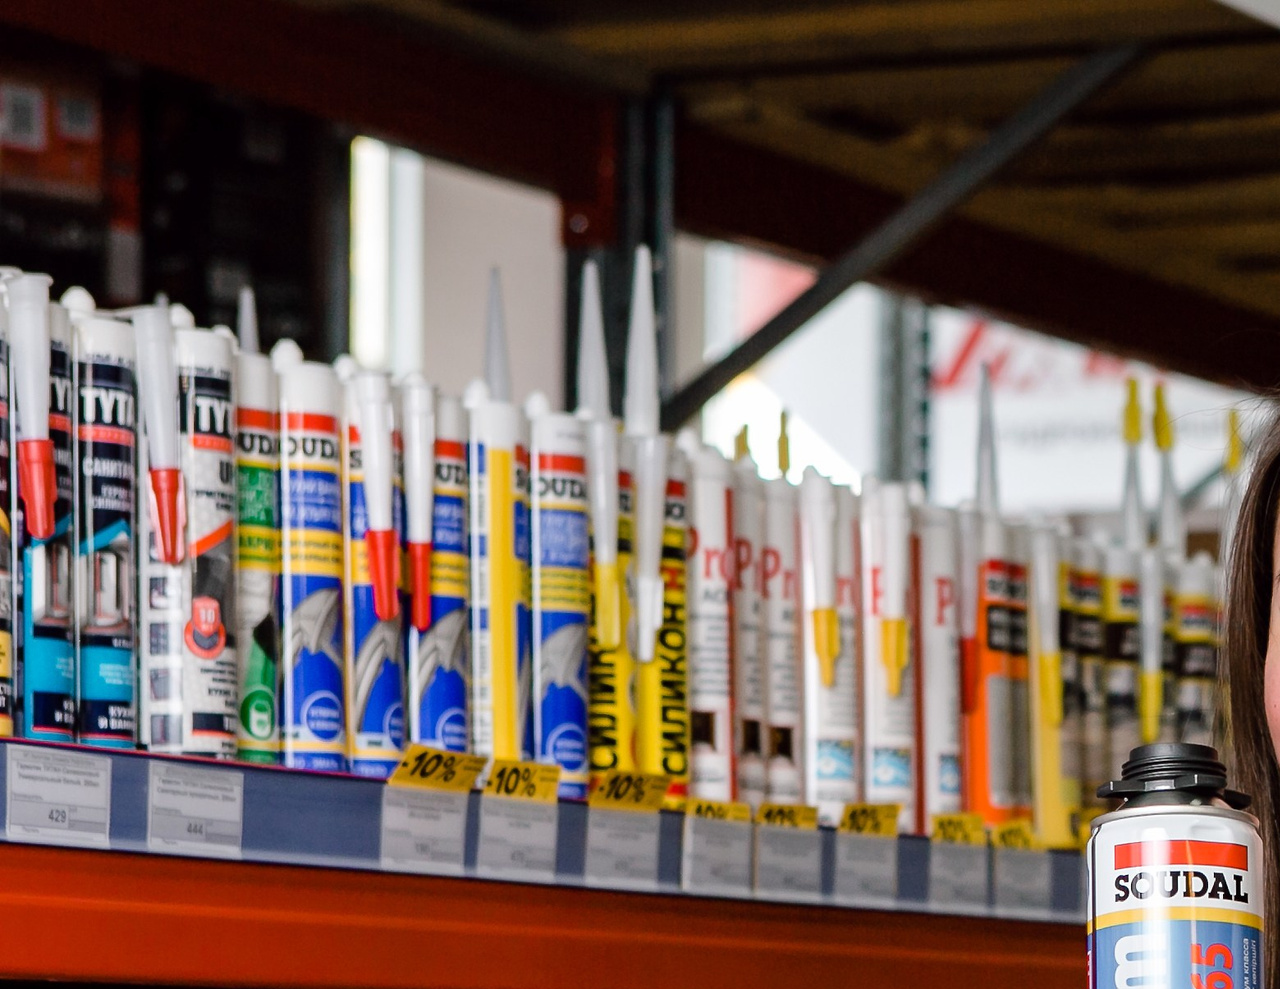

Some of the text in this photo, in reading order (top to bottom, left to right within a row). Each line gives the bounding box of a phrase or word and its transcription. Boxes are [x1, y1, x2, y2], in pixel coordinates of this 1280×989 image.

[659, 602, 686, 776] СИЛИКОН
[591, 648, 618, 772] СИЛИК
[401, 751, 457, 783] -10%
[486, 765, 537, 798] -10%
[1114, 871, 1249, 904] SOUDAL
